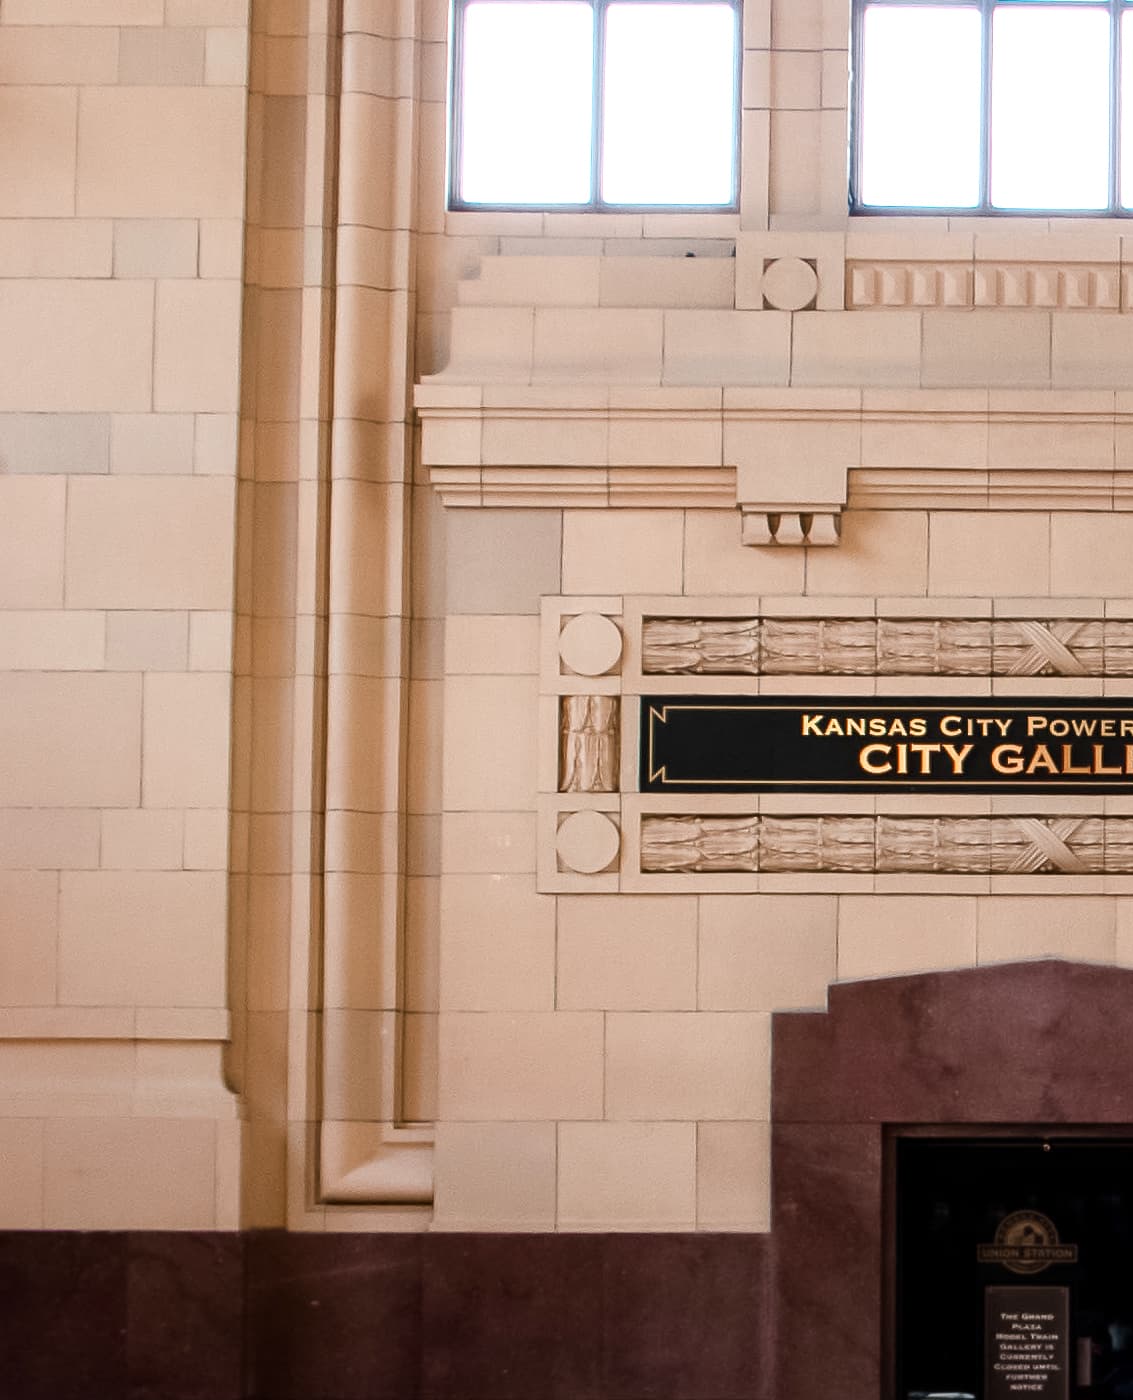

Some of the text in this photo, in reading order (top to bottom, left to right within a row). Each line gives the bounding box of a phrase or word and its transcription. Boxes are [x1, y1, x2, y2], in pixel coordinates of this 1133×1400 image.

[802, 715, 926, 737] KANSAS
[940, 715, 1012, 737] CITY
[858, 742, 974, 775] CITY
[1024, 1249, 1073, 1258] STATION
[1000, 1343, 1042, 1351] GALLERY
[1000, 1353, 1054, 1361] CURRENTLY
